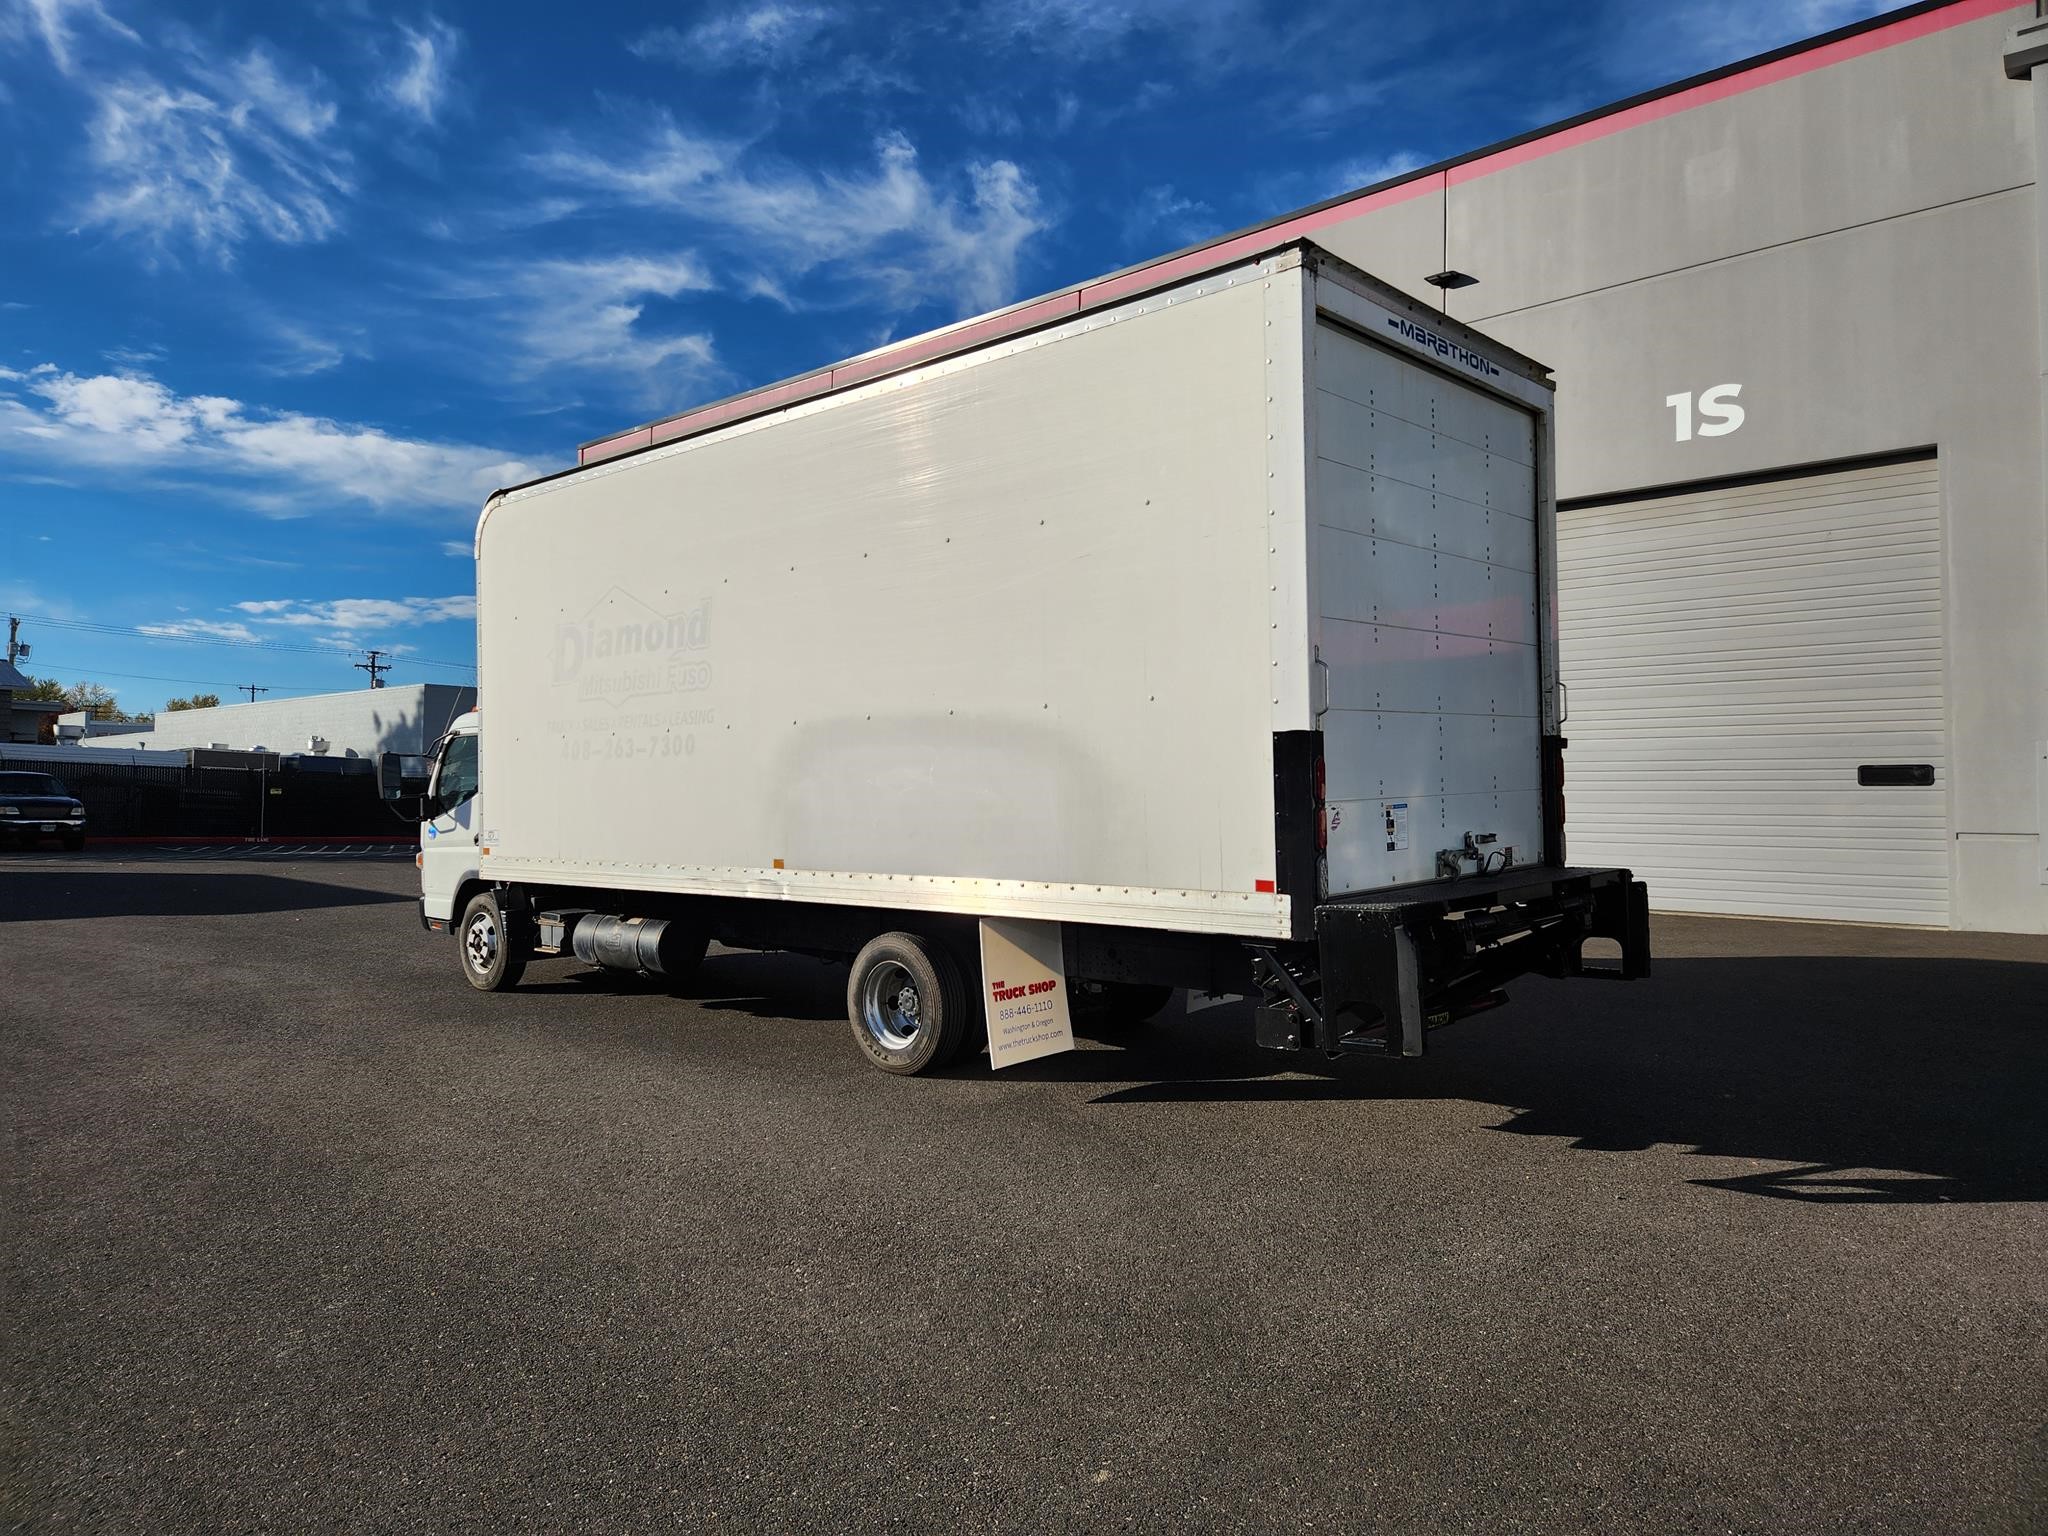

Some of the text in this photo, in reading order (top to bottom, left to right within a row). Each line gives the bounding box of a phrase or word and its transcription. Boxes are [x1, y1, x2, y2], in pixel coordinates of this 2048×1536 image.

[1665, 383, 1745, 442] 1S
[553, 596, 712, 682] Diamond
[582, 666, 662, 696] Mitsubishi
[992, 980, 1005, 990] THE
[993, 980, 1057, 1002] TRUCK SHOP
[999, 999, 1053, 1020] 888-446-1110
[1003, 1023, 1030, 1035] Washington
[1036, 1018, 1054, 1027] Oregon
[998, 1030, 1063, 1051] www.thetruckshop.com
